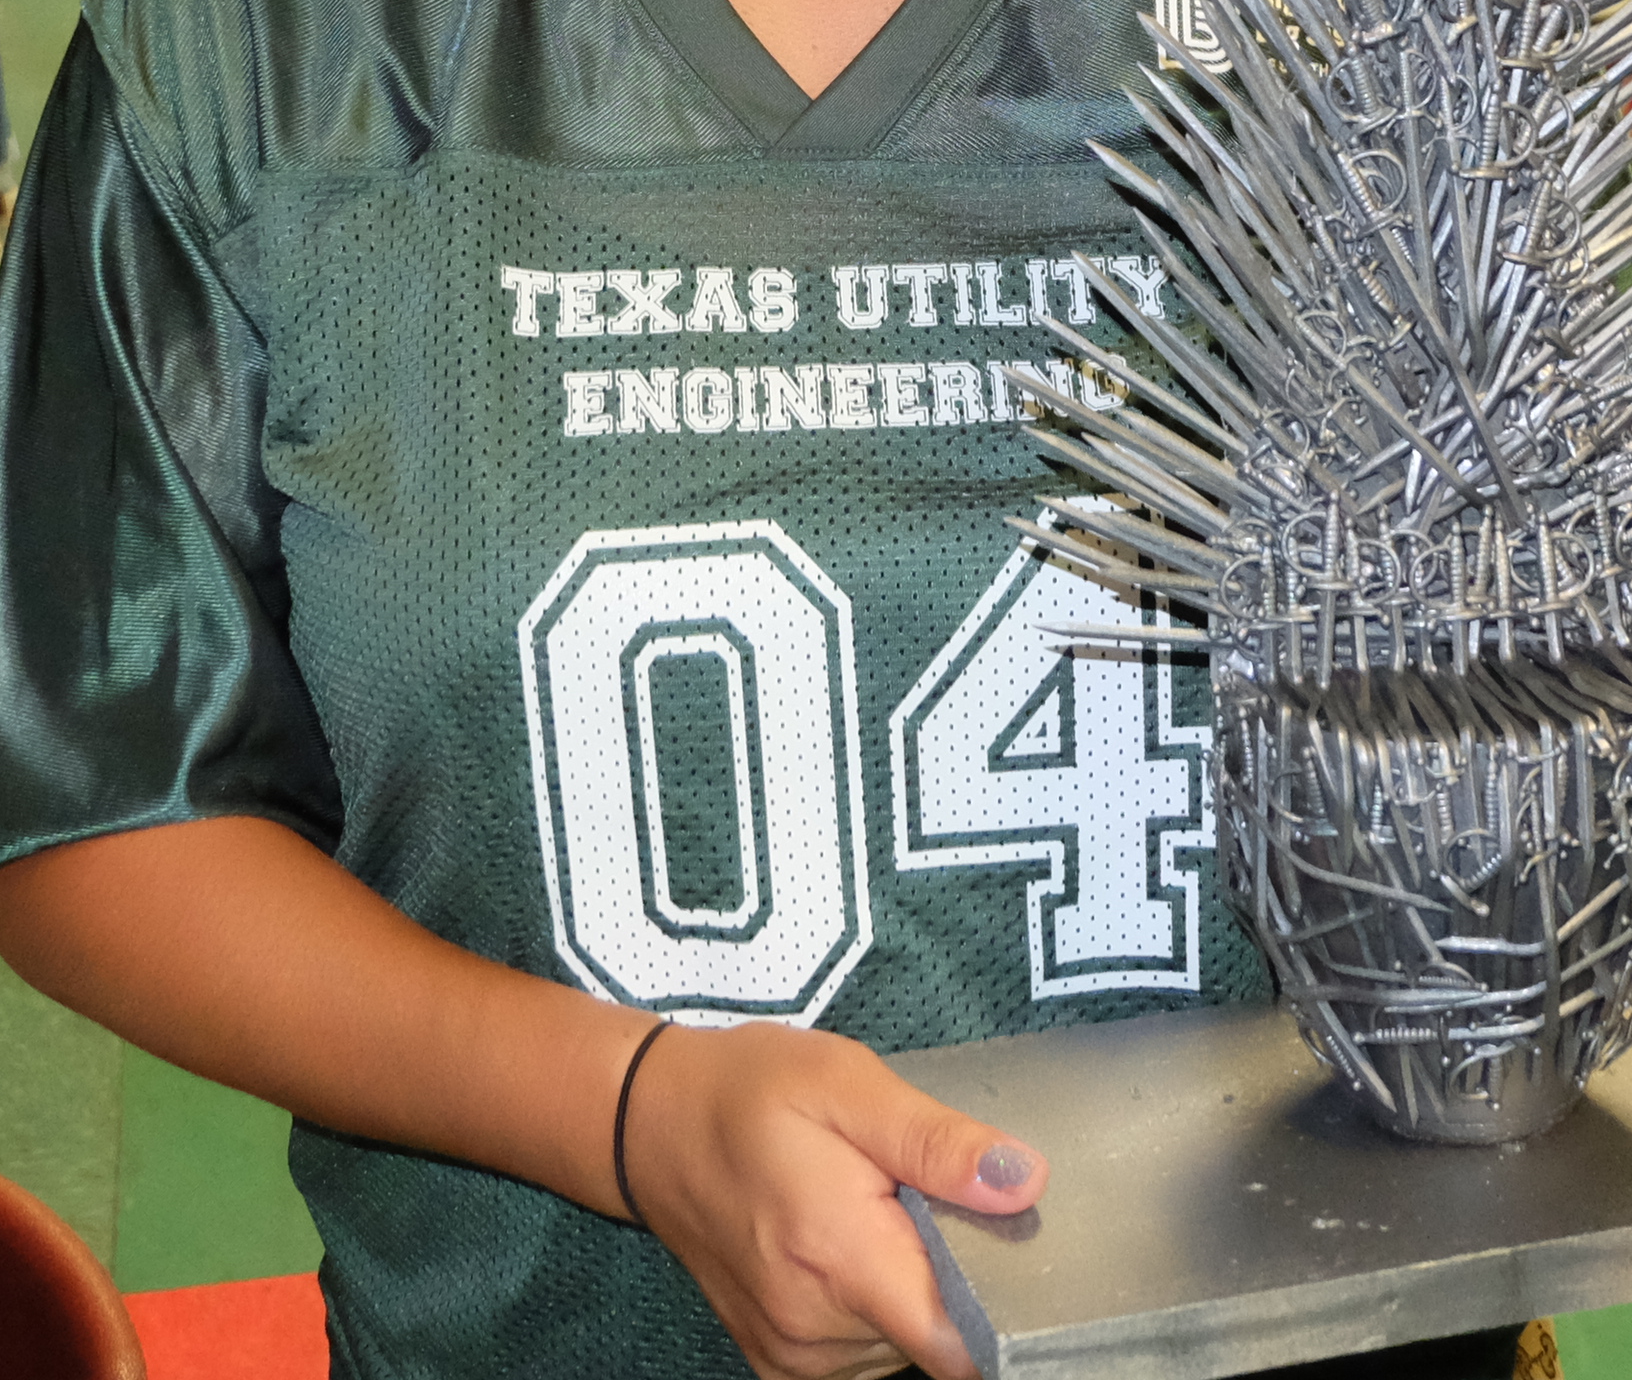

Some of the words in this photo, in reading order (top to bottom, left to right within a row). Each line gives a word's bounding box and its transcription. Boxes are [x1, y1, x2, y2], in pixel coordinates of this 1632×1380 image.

[501, 264, 798, 338] TEXAS
[831, 255, 1168, 329] UTILITY
[562, 355, 1133, 437] ENGINEERING
[518, 496, 1216, 1029] 04
